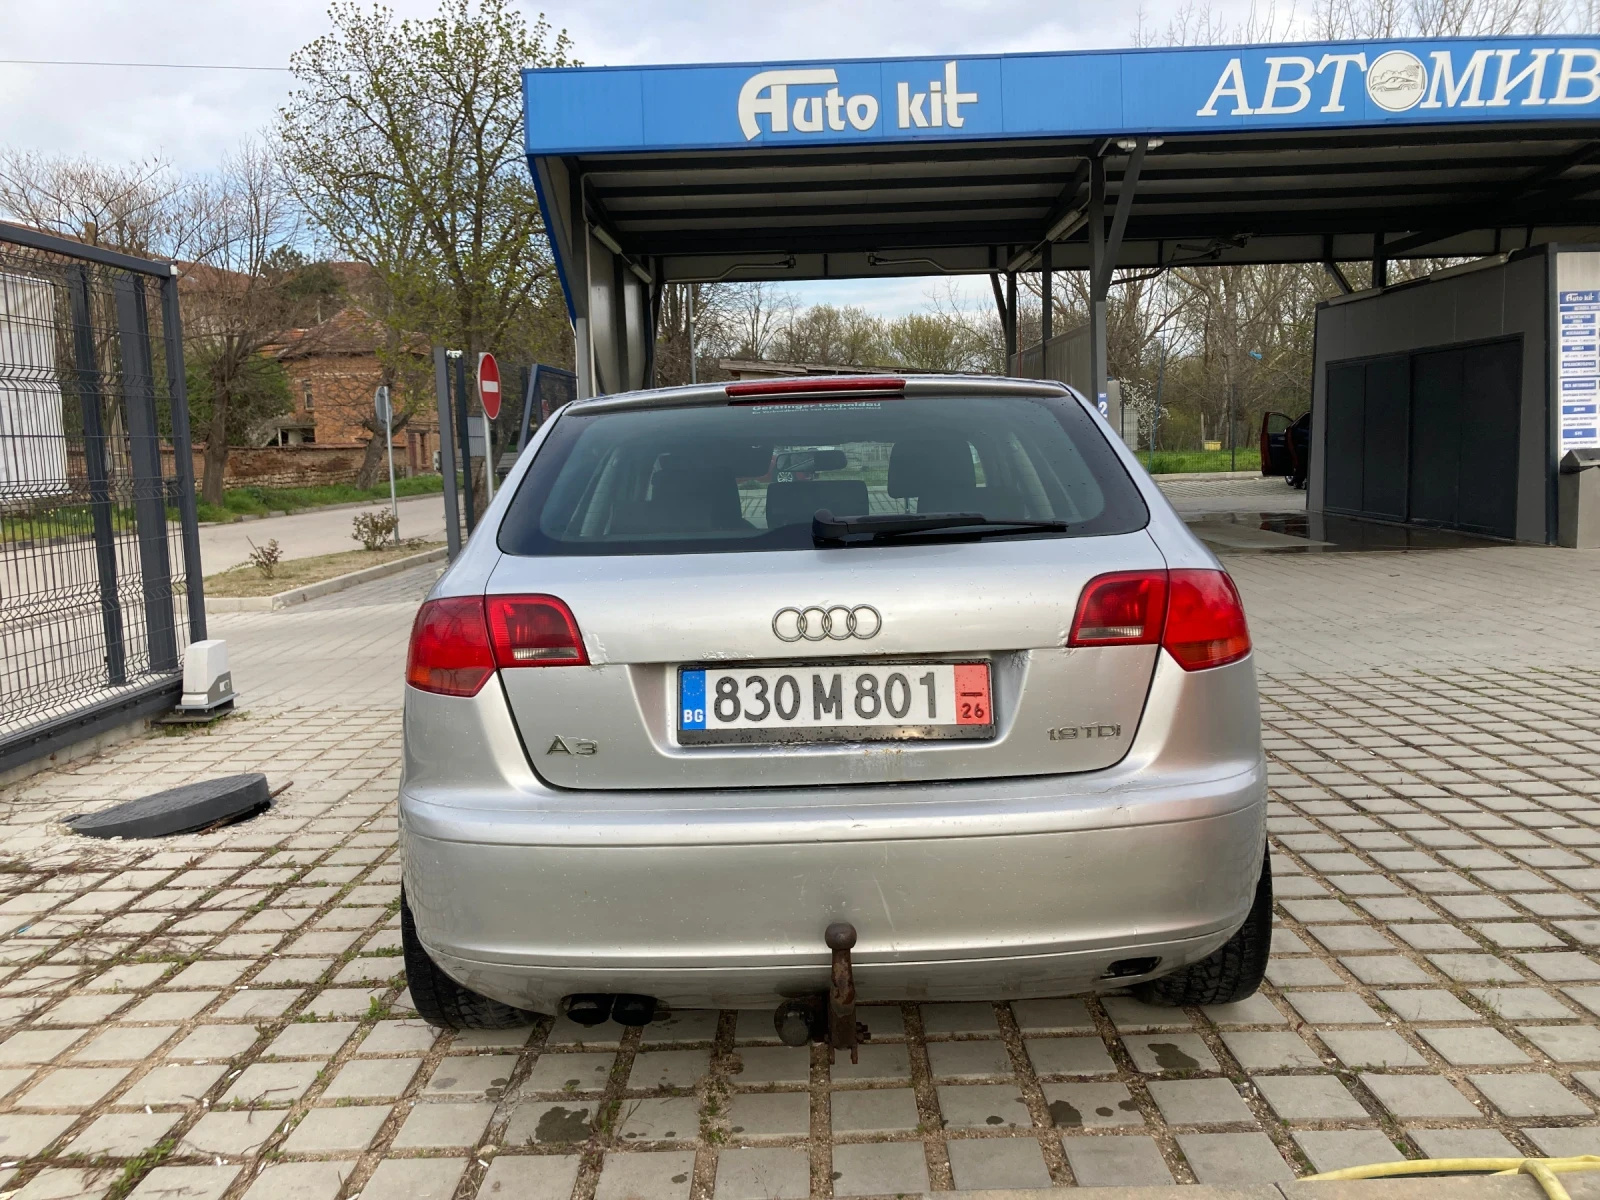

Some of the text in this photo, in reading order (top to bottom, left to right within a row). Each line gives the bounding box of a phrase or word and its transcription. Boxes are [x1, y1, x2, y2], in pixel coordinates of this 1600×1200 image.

[737, 60, 979, 141] Auto kit
[1099, 401, 1108, 418] 2
[714, 671, 937, 722] 830 M 801
[683, 708, 704, 723] BG
[961, 702, 985, 719] 26
[546, 734, 598, 756] A3
